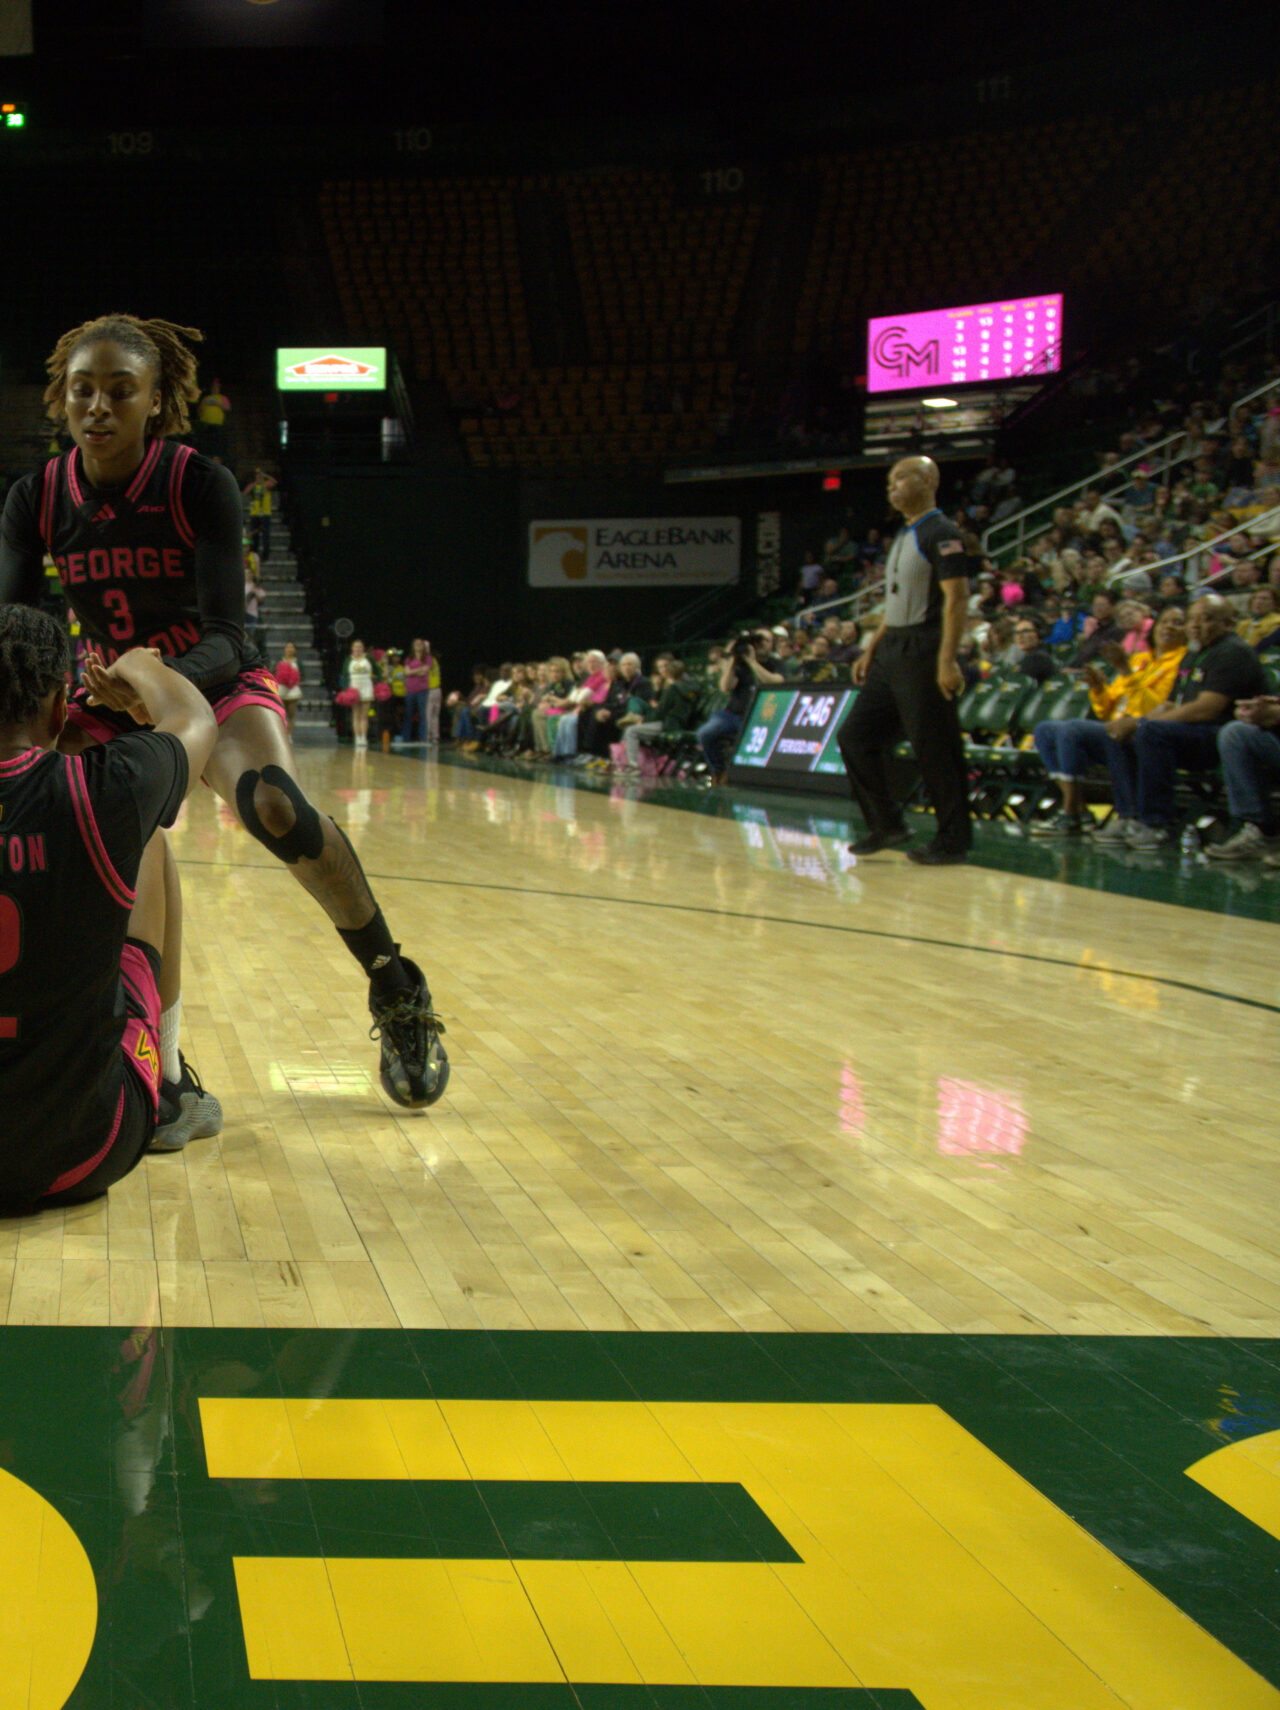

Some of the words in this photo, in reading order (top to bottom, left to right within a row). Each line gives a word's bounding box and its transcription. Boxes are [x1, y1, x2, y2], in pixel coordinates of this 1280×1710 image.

[107, 130, 154, 155] 109
[699, 166, 744, 194] 110
[873, 326, 940, 377] GM
[55, 547, 185, 586] GEORGE
[103, 588, 136, 641] 3
[793, 695, 836, 727] 7:46
[745, 726, 769, 753] 39
